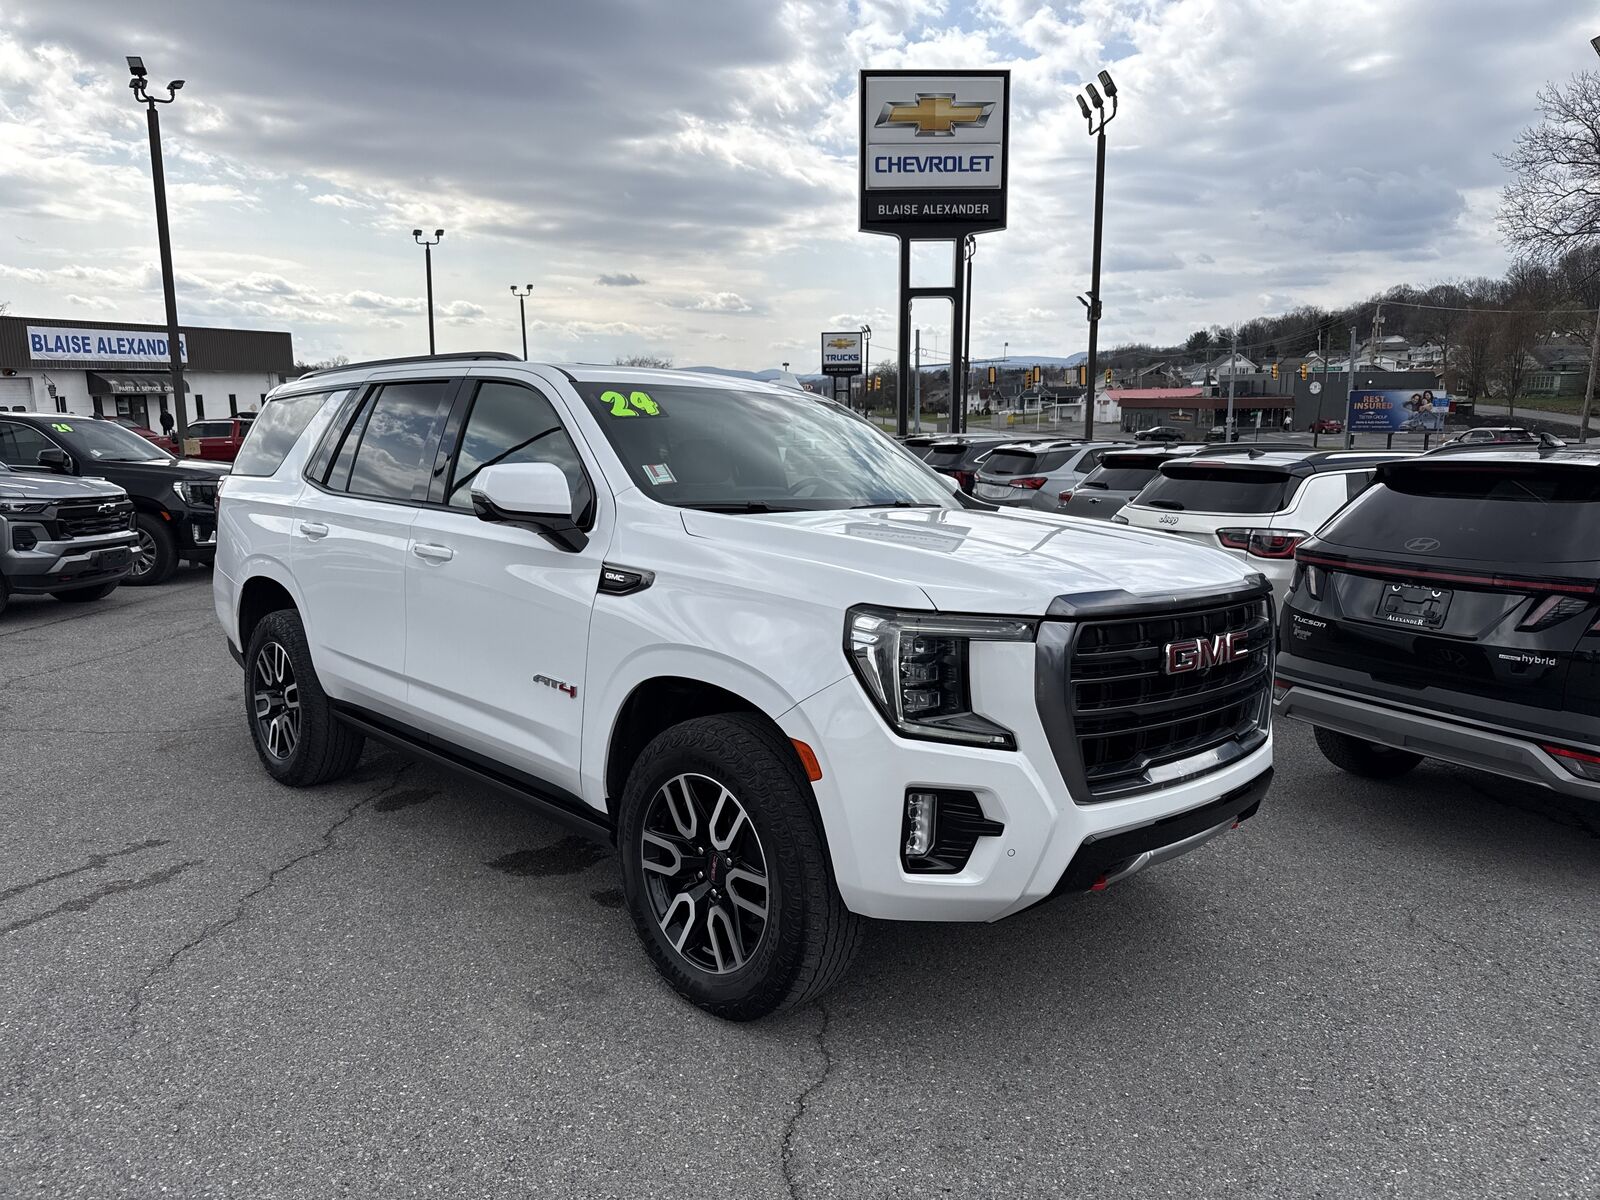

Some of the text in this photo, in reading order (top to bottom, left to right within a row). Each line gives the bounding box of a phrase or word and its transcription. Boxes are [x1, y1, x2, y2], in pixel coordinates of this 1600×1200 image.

[874, 155, 995, 173] CHEVROLET
[878, 204, 989, 215] BLAISE ALEXANDER
[30, 333, 186, 356] BLAISE ALEXANDR
[825, 353, 860, 361] TRUCKS
[600, 390, 660, 416] 24
[1363, 395, 1385, 403] REST
[1353, 402, 1394, 410] INSURED
[1158, 513, 1179, 526] Jeep
[605, 572, 625, 582] GMC
[1165, 631, 1249, 676] GMC
[1521, 654, 1556, 666] hybrid
[532, 674, 577, 699] AT4
